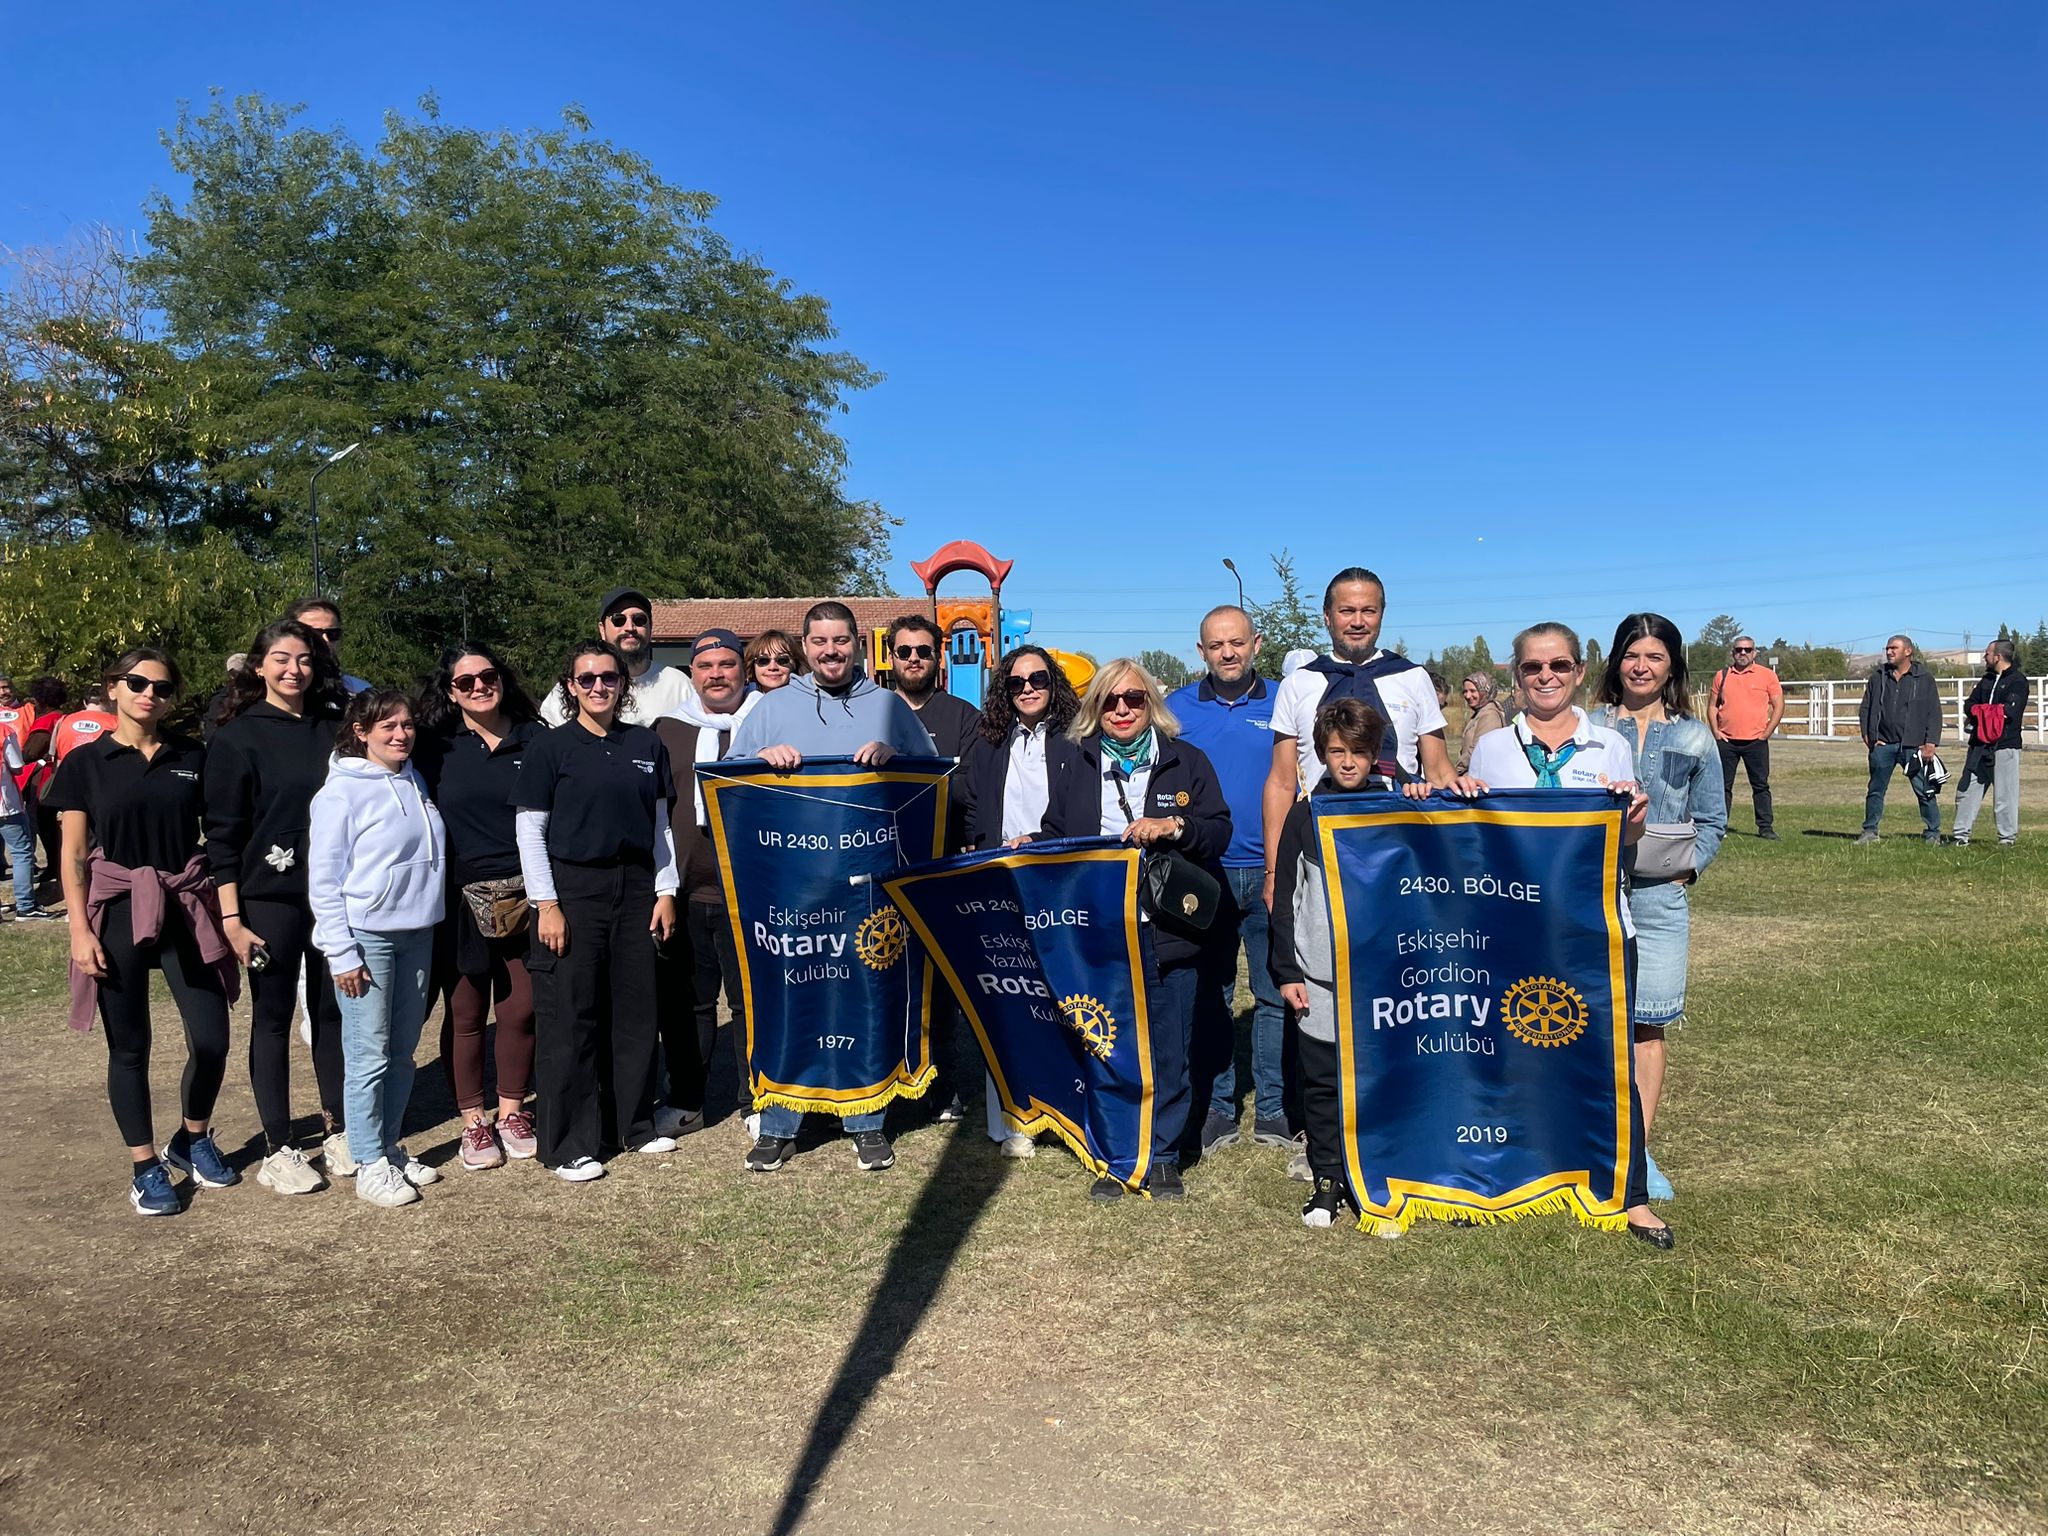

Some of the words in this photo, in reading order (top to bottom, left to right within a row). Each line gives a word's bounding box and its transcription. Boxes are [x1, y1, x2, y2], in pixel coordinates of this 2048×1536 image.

[1572, 769, 1597, 779] Rotary
[758, 830, 782, 848] UR
[787, 833, 834, 850] 2430.
[840, 825, 900, 850] BÖLGE
[1400, 876, 1455, 896] 2430.
[1464, 874, 1541, 903] BÖLGE
[768, 905, 847, 930] Eskişehir
[955, 901, 986, 914] UR
[1024, 909, 1089, 931] BÖLGE
[754, 921, 847, 958] Rotary
[1397, 928, 1490, 955] Eskişehir
[784, 962, 850, 985] Kulübü
[1401, 962, 1490, 988] Gordion
[1524, 983, 1561, 992] ROTARY
[1062, 1002, 1093, 1012] ROTARY
[1372, 991, 1491, 1030] Rotary
[816, 1035, 855, 1050] 1977
[1416, 1031, 1495, 1055] Kulübü
[1515, 1022, 1576, 1040] INTERNATIONAL
[1456, 1126, 1507, 1143] 2019
